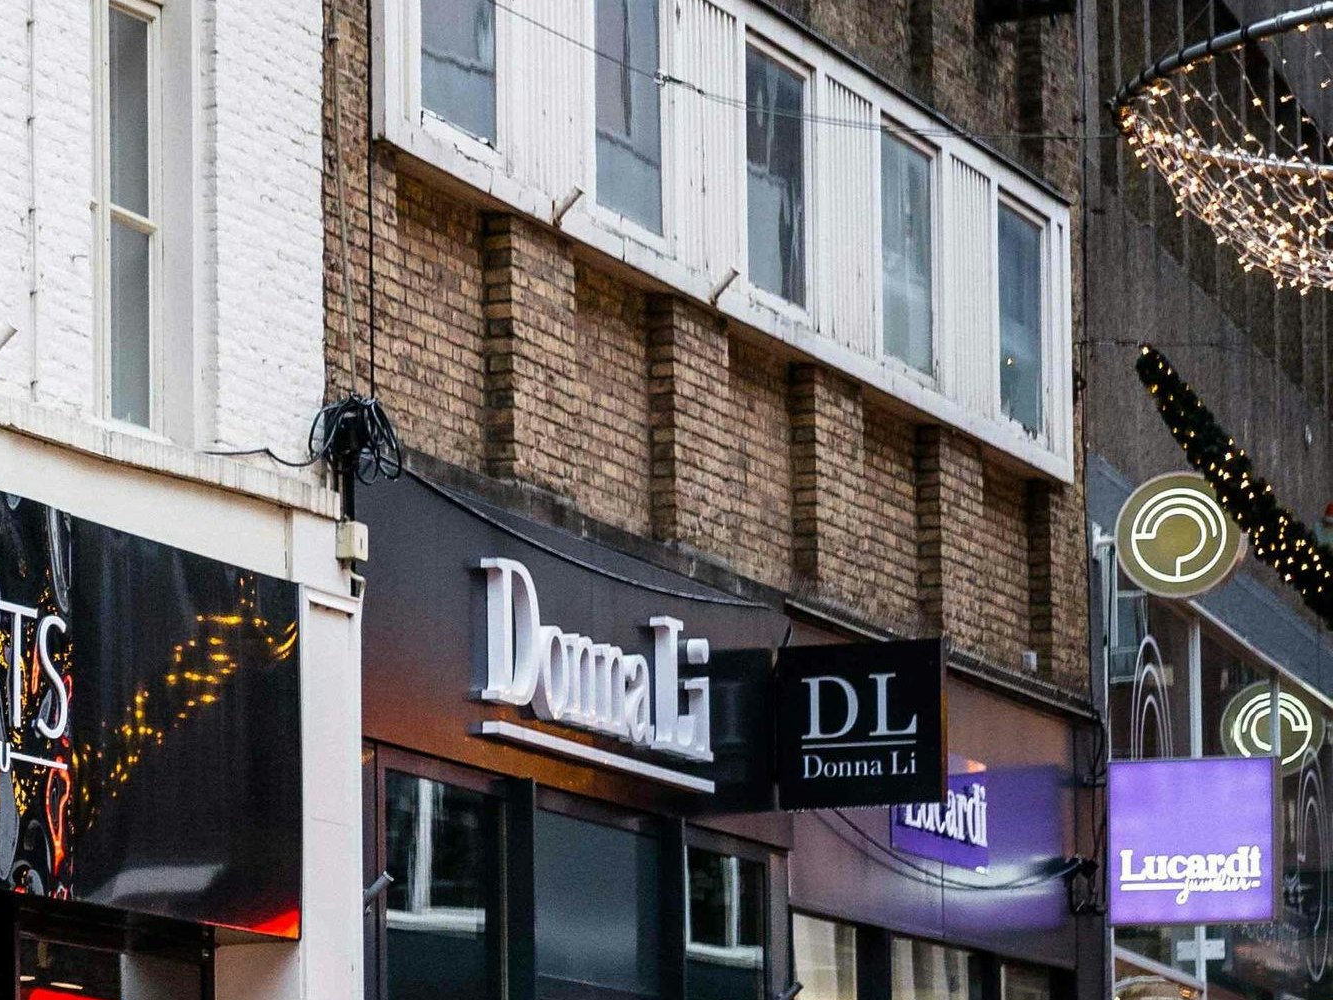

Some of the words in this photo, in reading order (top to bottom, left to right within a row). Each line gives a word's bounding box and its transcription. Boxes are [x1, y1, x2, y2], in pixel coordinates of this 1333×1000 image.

[802, 754, 883, 780] Donna
[890, 748, 917, 775] Li
[1120, 845, 1261, 882] Lucardi
